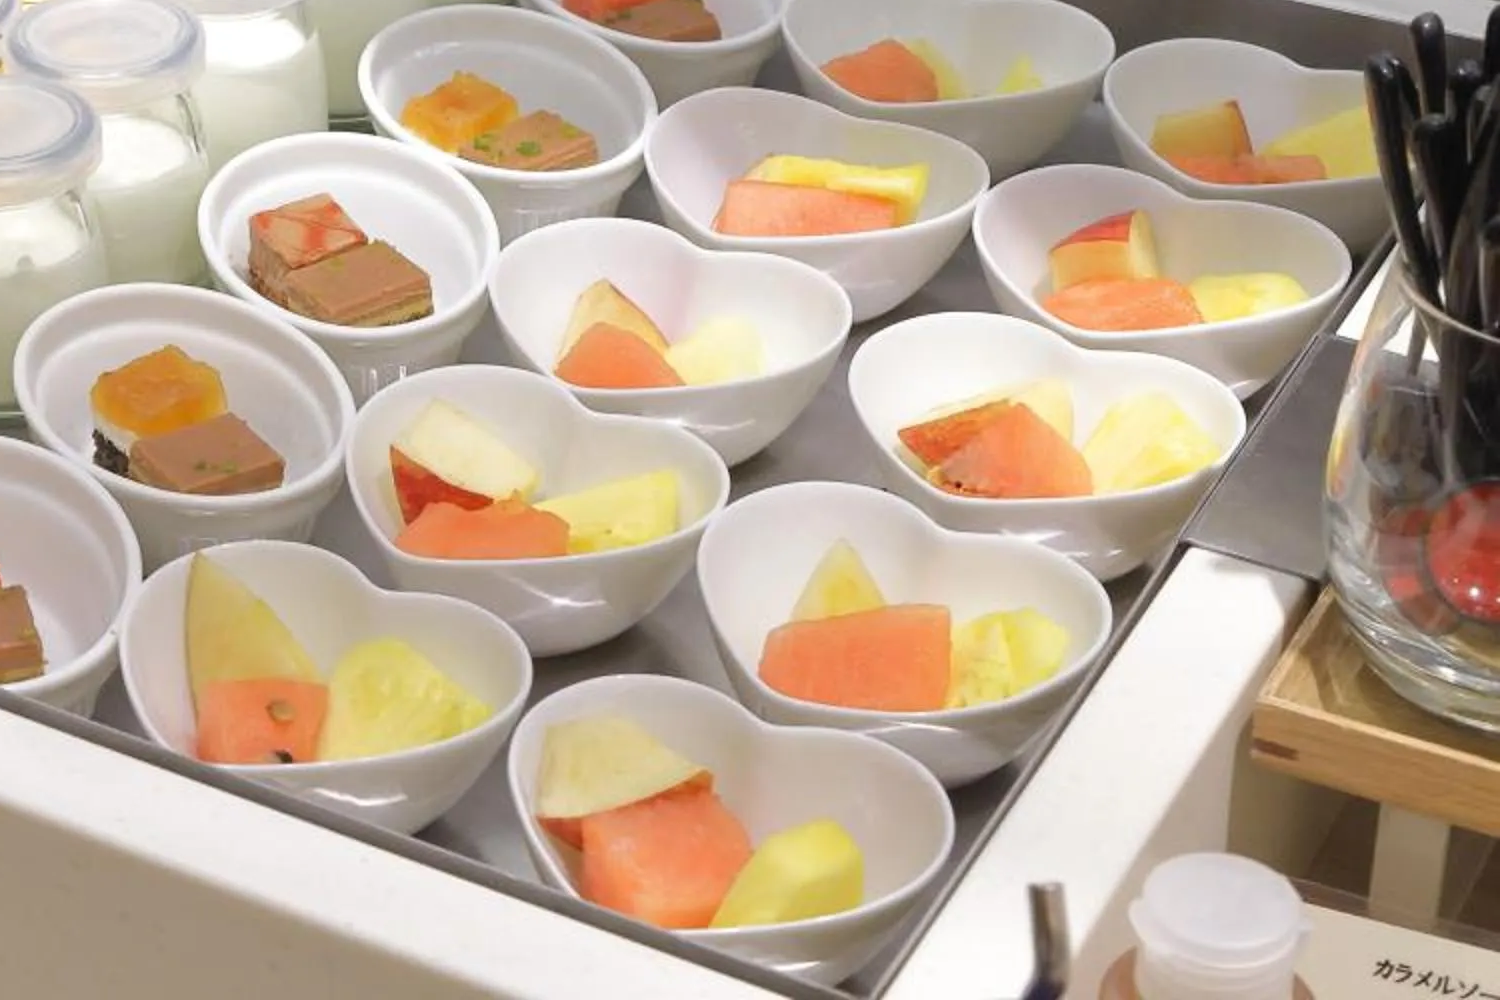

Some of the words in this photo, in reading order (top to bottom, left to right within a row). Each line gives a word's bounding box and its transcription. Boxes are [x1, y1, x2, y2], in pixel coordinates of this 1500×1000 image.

[1373, 958, 1500, 999] カラメルソー
